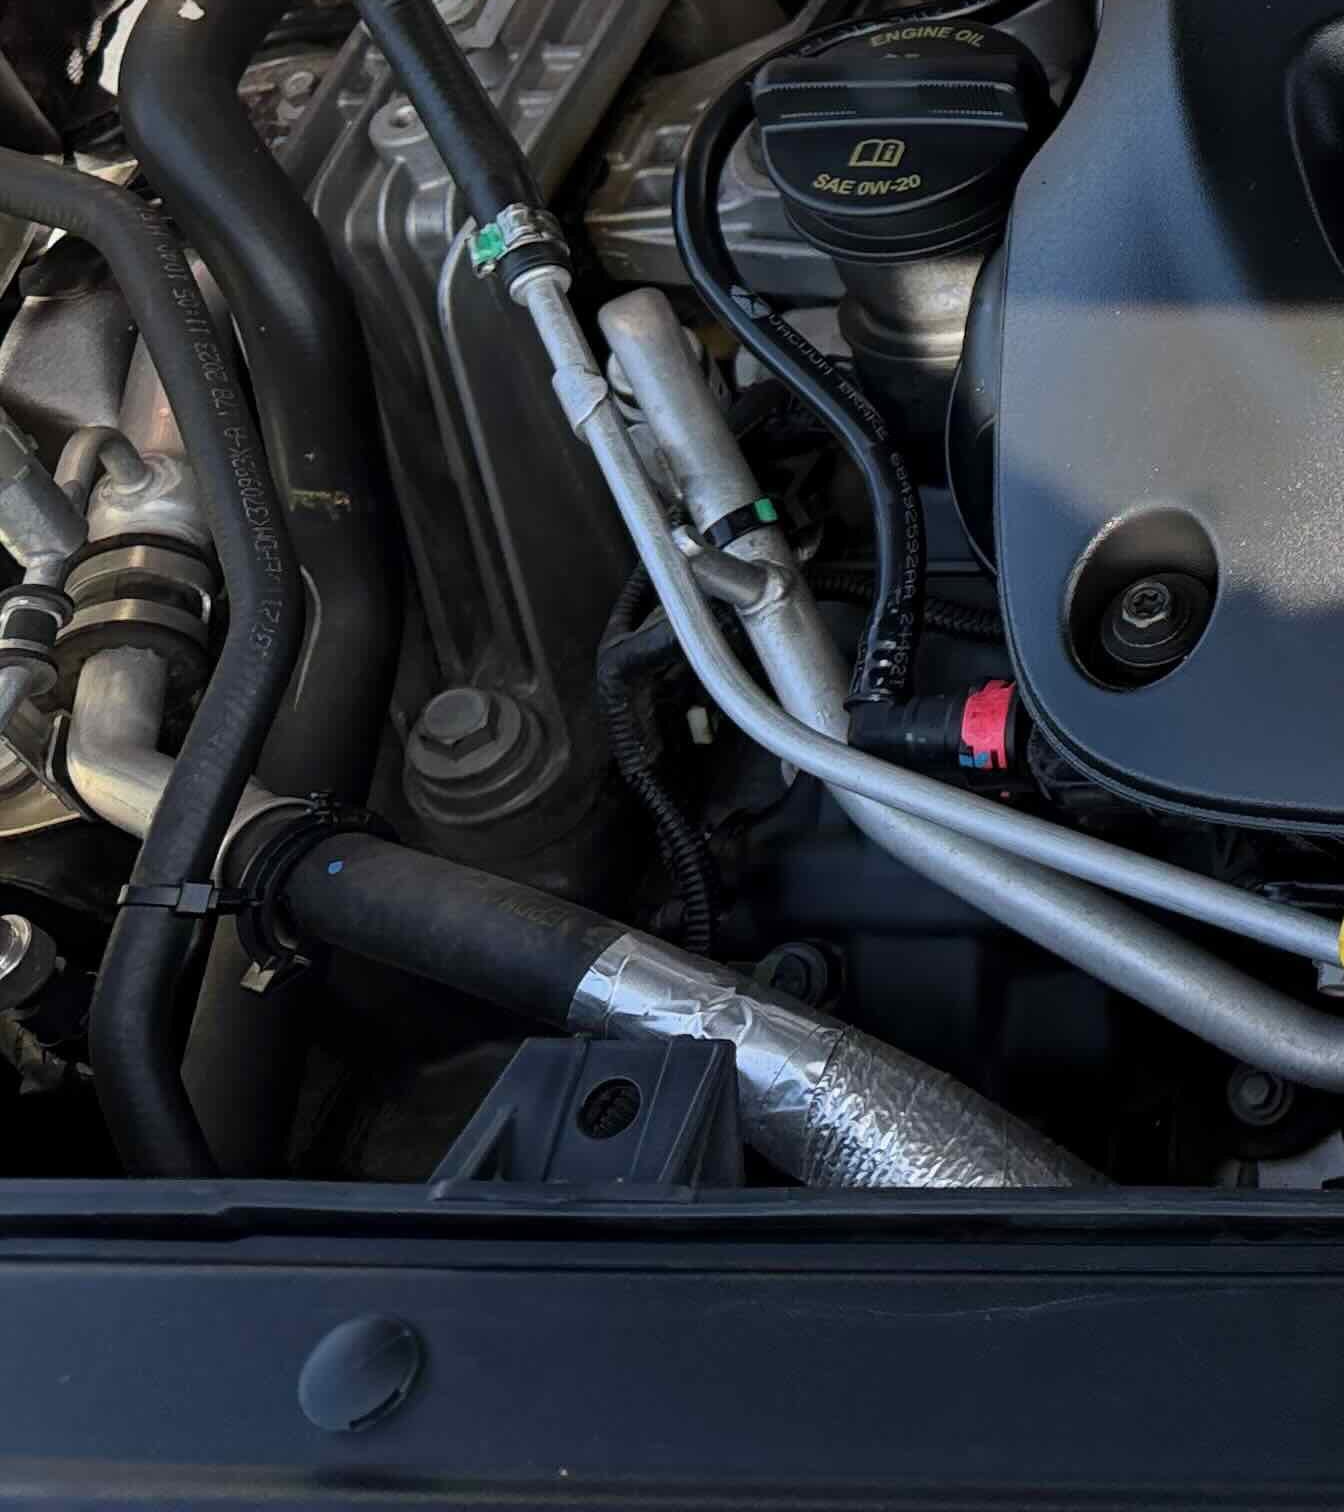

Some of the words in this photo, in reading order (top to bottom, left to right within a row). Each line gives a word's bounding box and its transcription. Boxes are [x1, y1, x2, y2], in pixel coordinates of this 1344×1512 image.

[870, 25, 951, 48] ENGINE
[955, 27, 987, 49] OIL
[812, 174, 855, 195] SAE
[858, 173, 921, 196] 0W-20
[767, 311, 835, 377] VACUUM
